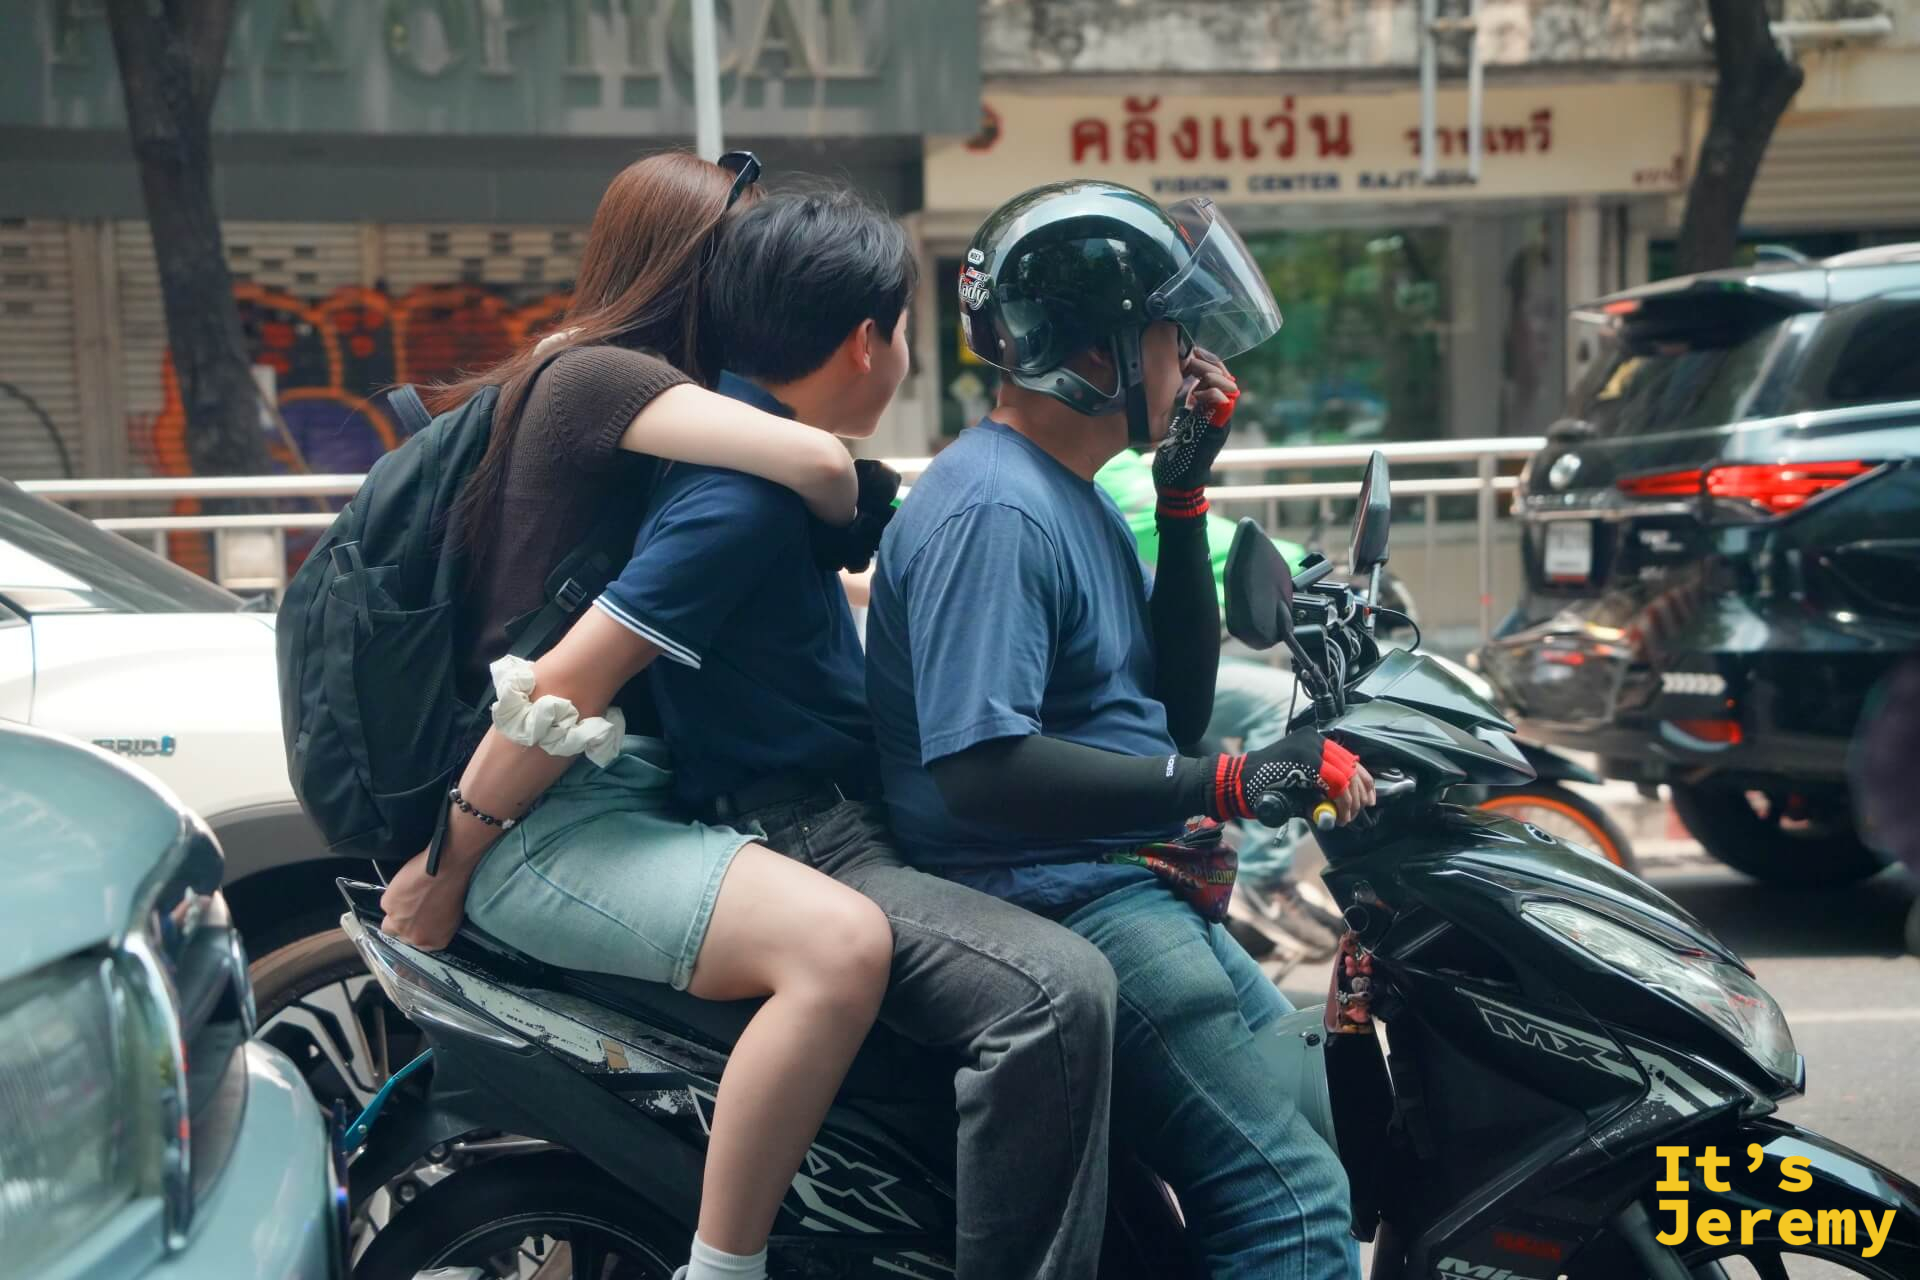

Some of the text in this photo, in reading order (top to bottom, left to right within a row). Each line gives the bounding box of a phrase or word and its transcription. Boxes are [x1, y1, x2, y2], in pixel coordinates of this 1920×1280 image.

[1070, 96, 1354, 163] คลังแว่น
[1152, 176, 1229, 193] VISION
[1248, 173, 1340, 191] CENTER
